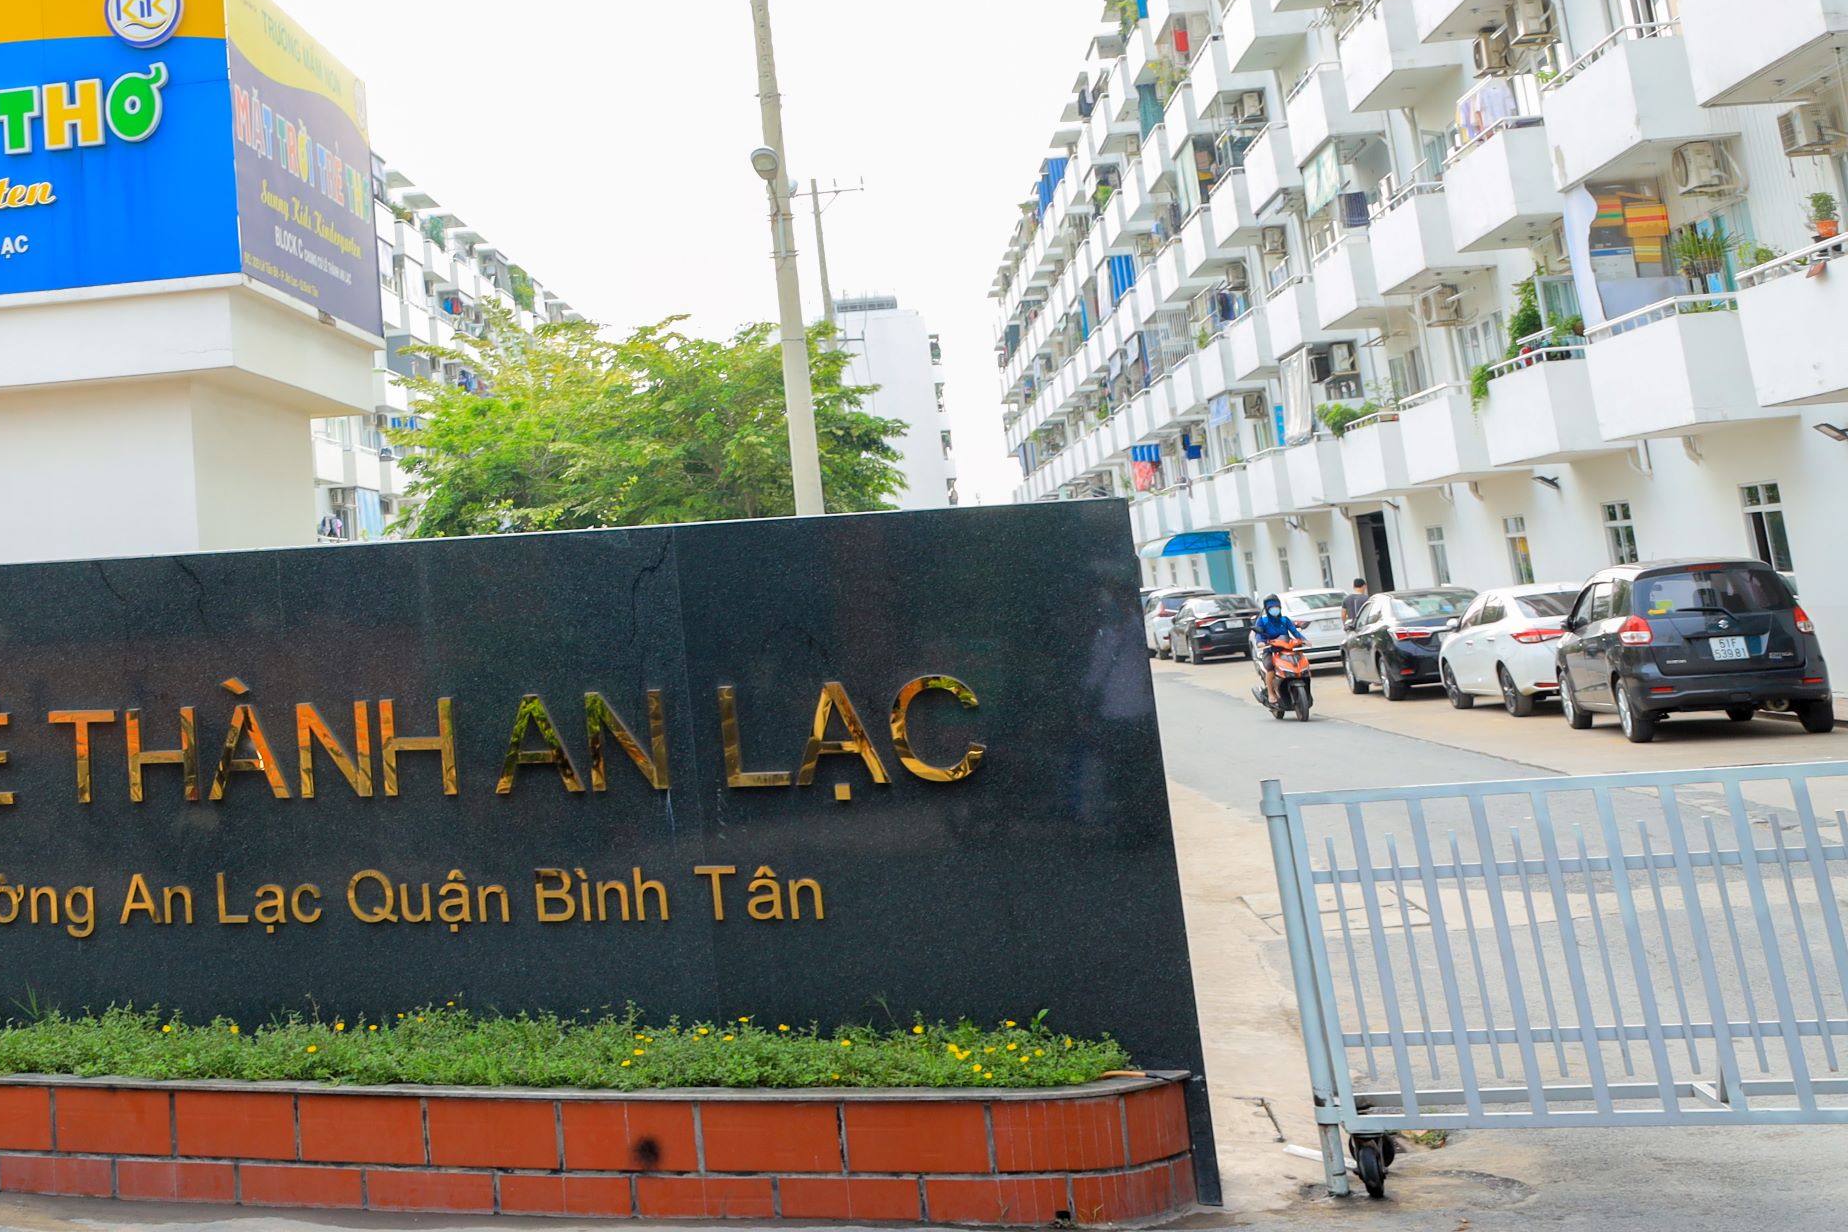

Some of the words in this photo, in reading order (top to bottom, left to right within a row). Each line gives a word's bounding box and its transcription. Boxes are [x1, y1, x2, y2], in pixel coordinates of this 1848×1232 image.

[274, 225, 299, 257] BLOCK
[1719, 638, 1737, 648] 51F
[48, 677, 458, 803] THÀNH
[495, 689, 670, 794] AN
[718, 675, 987, 801] LẠC
[119, 873, 193, 924] An
[217, 872, 323, 933] Lạc
[347, 868, 510, 933] Quận
[534, 867, 669, 922] Bình
[694, 865, 825, 921] Tân
